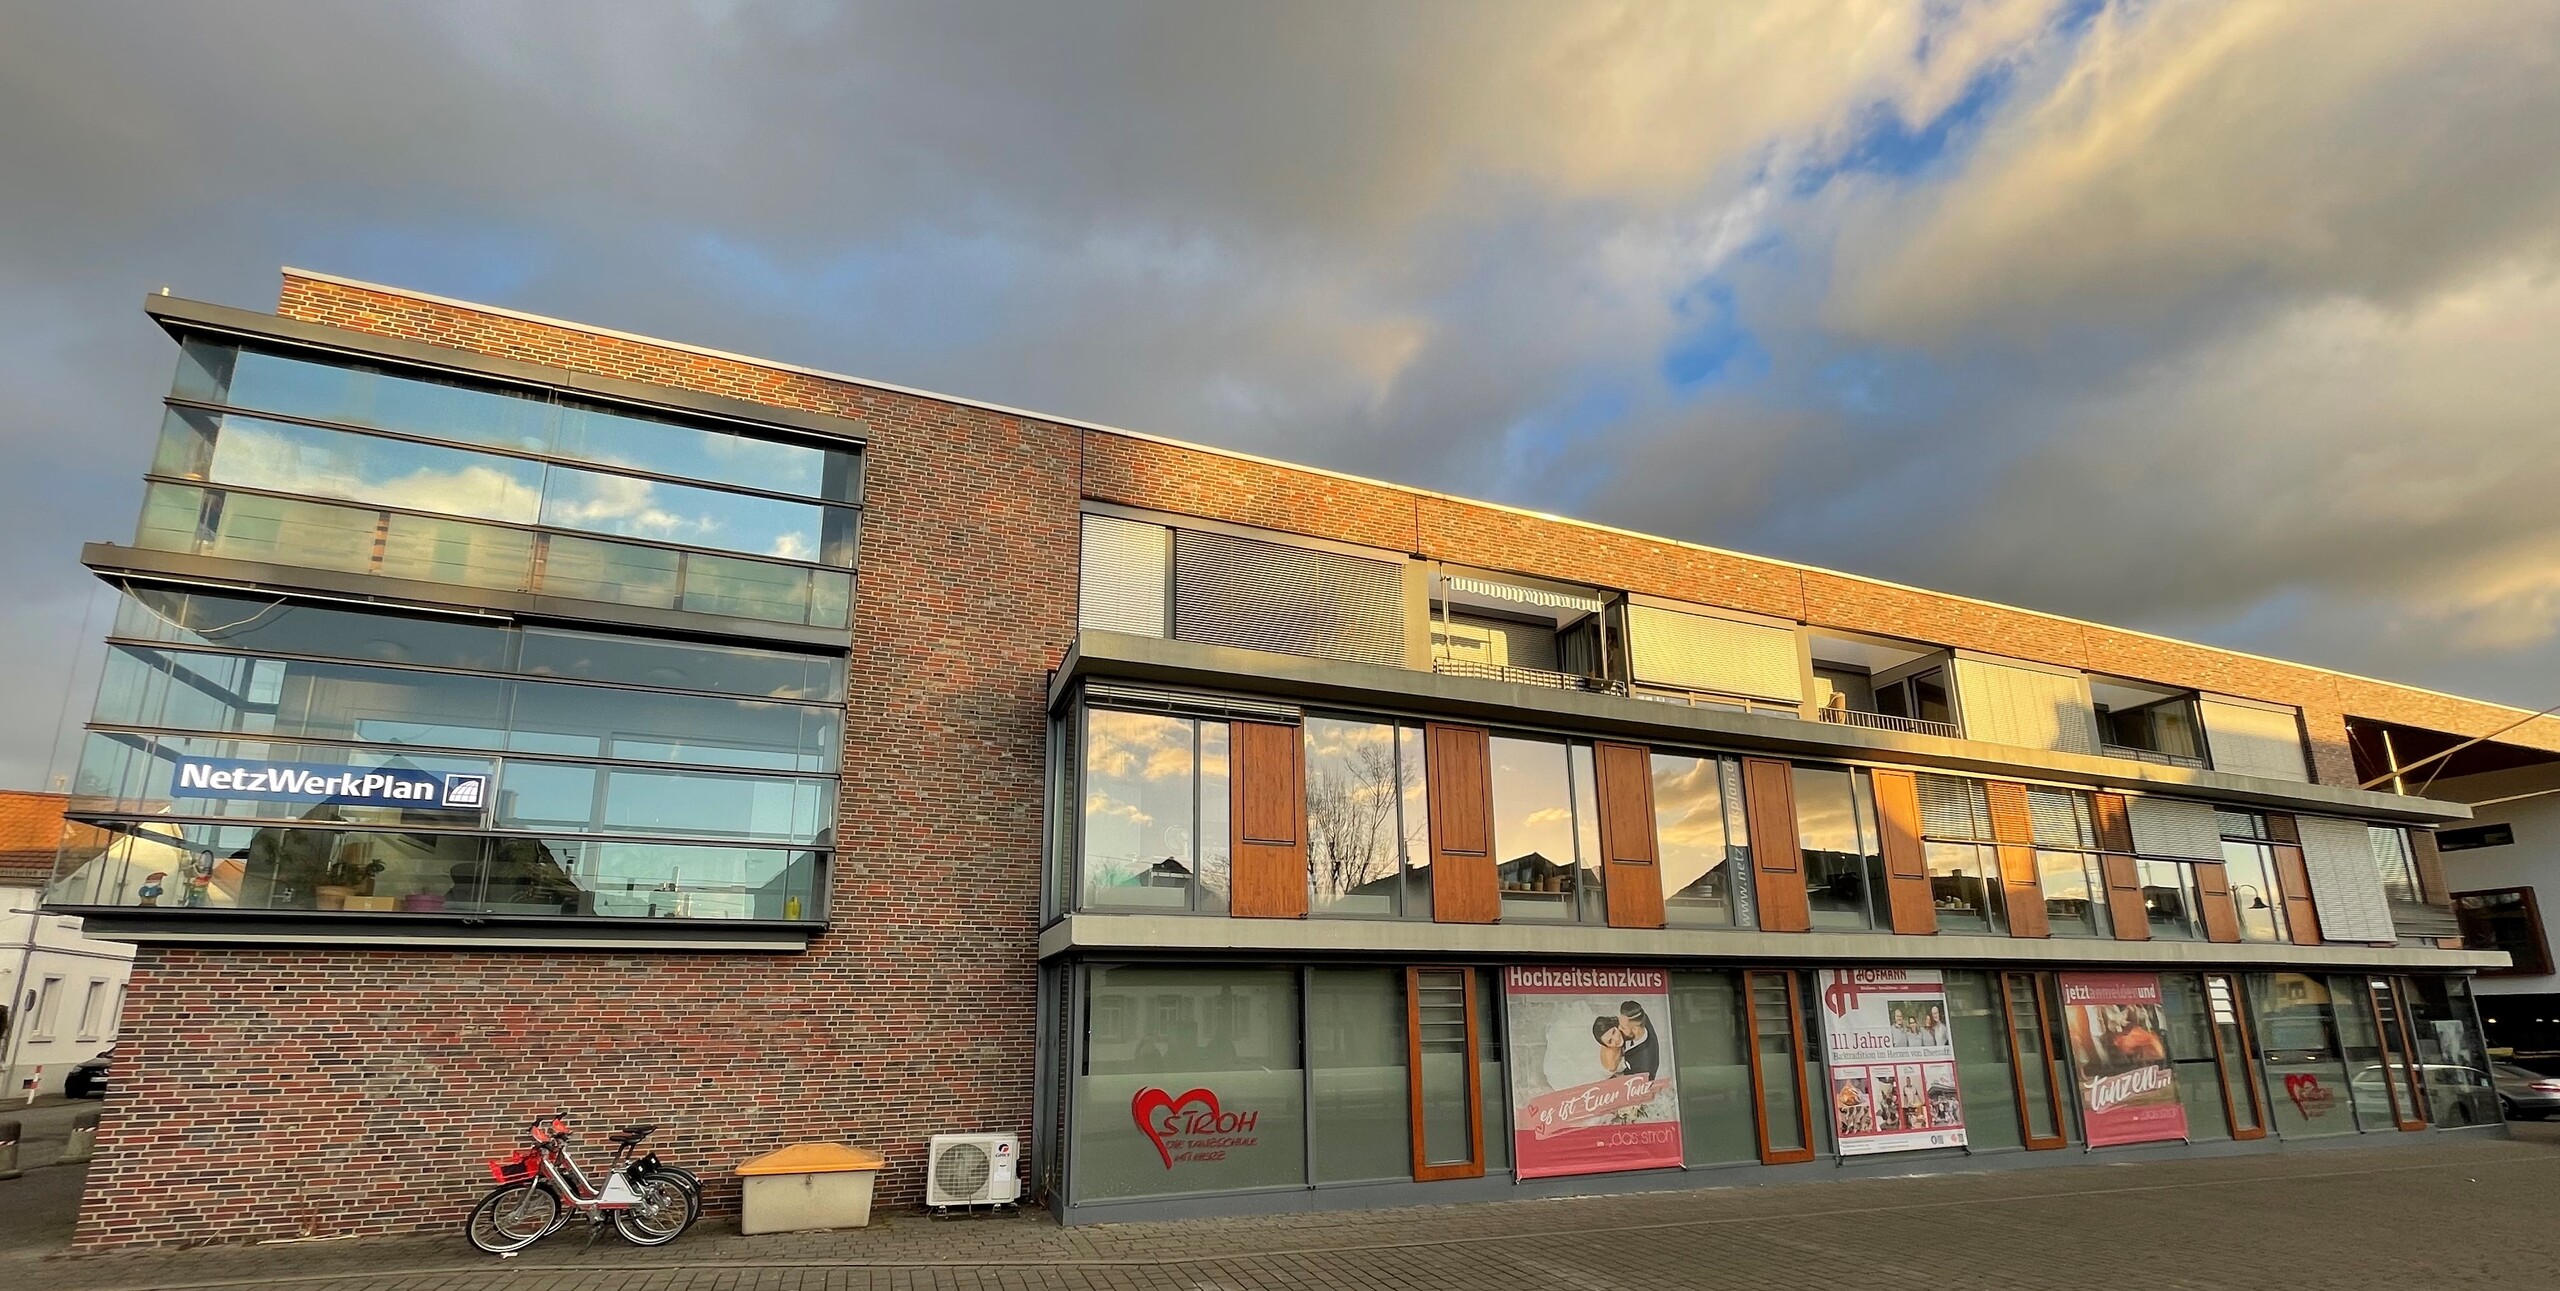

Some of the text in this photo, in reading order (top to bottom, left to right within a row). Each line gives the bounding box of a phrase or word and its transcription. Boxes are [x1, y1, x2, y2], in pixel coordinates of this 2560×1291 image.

[180, 763, 434, 801] NetzWerkPlan
[1725, 756, 1751, 927] www.netzrkplan.de
[1510, 966, 1662, 988] Hochzeitstanzkurs
[1853, 1031, 1891, 1050] Jahre
[1540, 1076, 1654, 1125] es ist Euer Tanz
[1158, 1110, 1259, 1137] STROH
